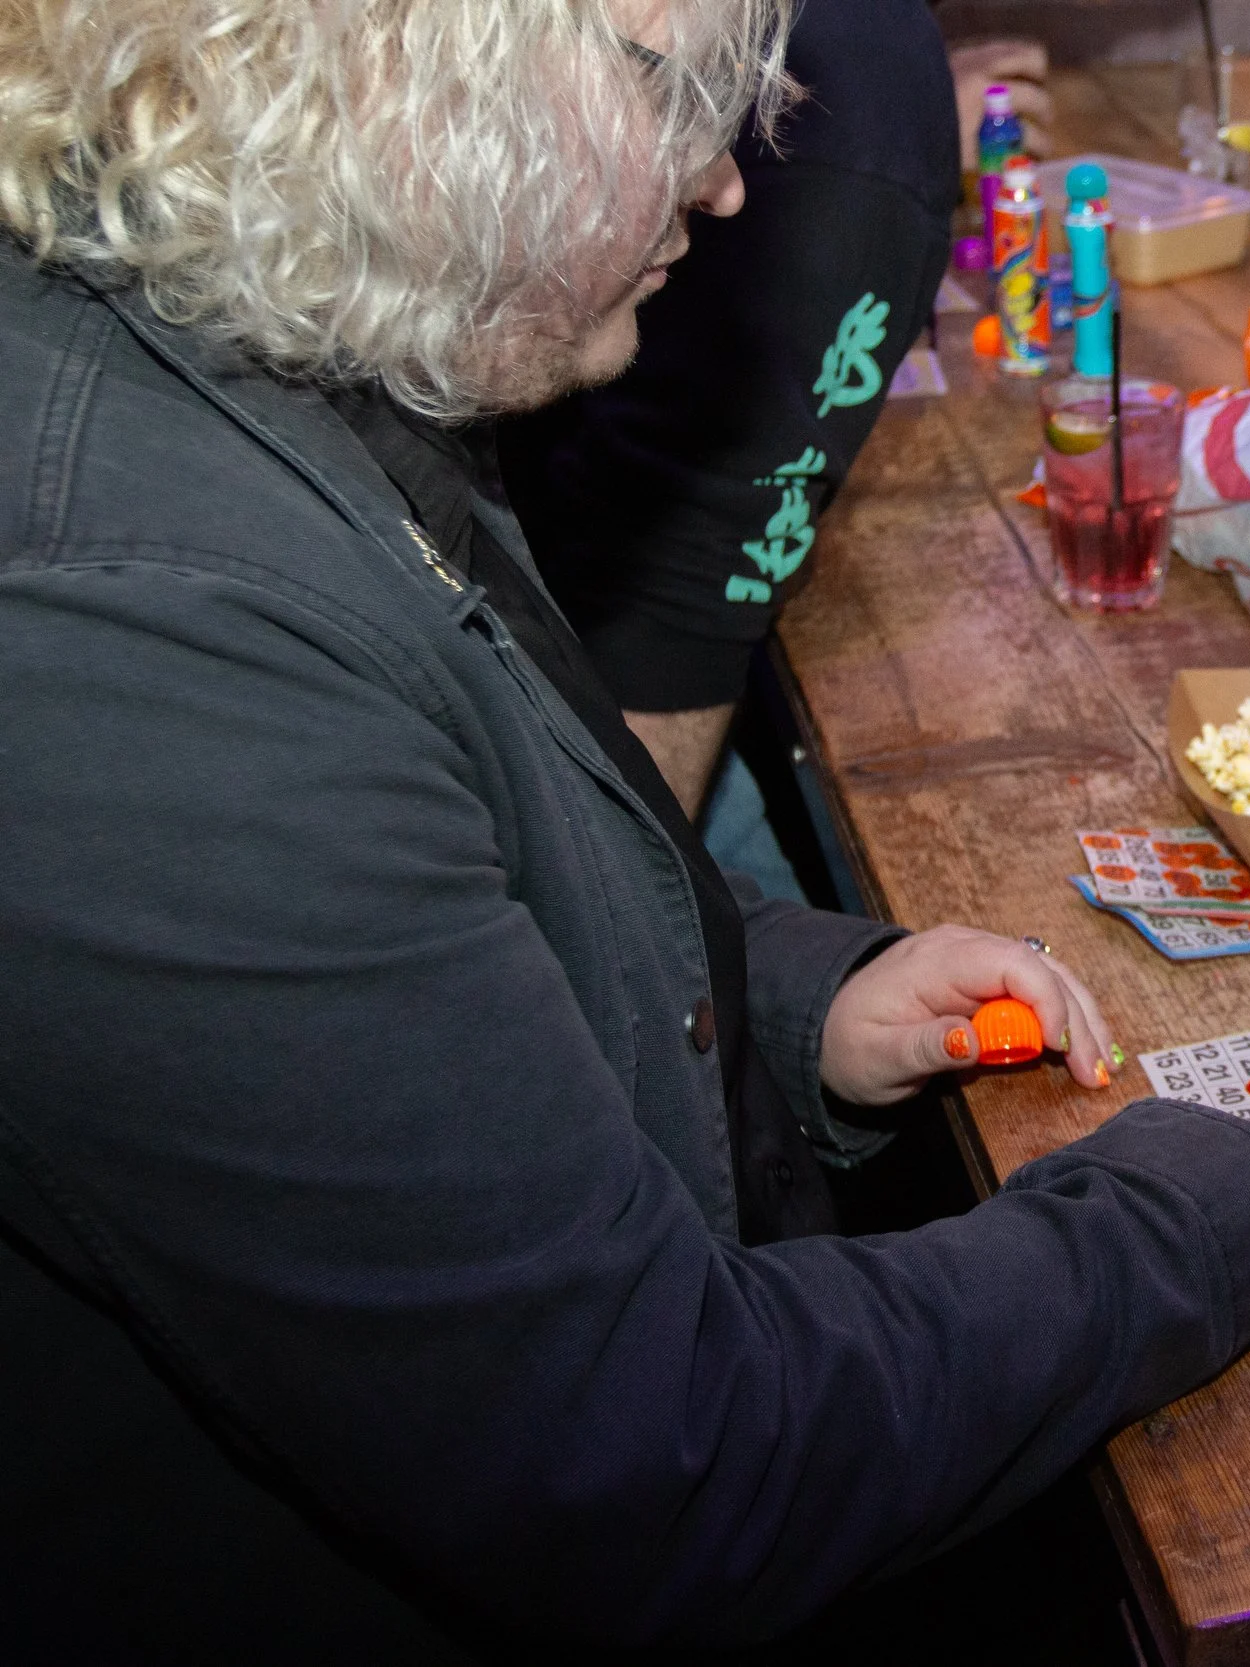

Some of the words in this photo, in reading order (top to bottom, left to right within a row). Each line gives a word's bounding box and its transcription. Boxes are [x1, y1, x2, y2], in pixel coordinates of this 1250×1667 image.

[1154, 1052, 1182, 1069] 15
[1191, 1044, 1219, 1061] 12
[1164, 1073, 1195, 1091] 23
[1202, 1064, 1232, 1082] 21
[1216, 1087, 1245, 1105] 40
